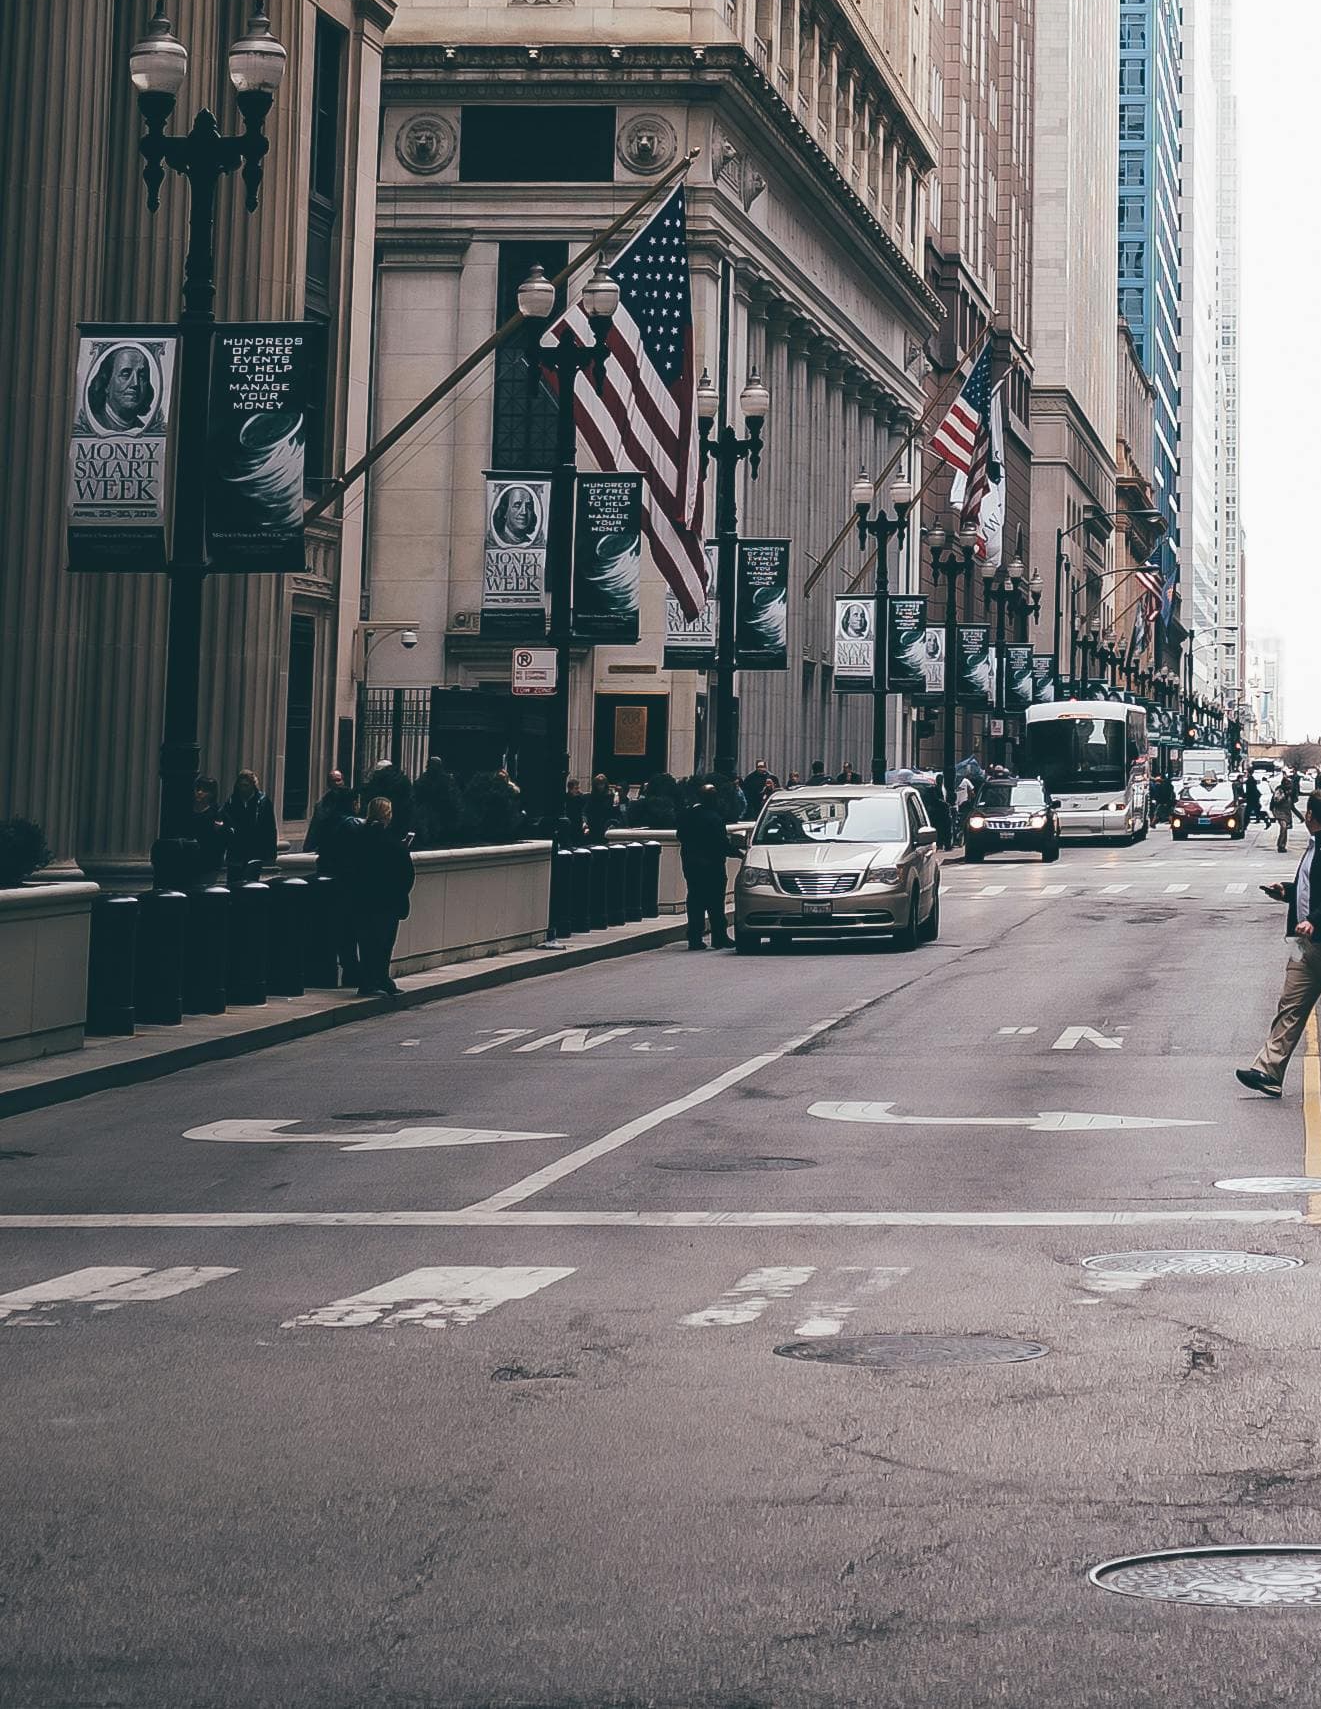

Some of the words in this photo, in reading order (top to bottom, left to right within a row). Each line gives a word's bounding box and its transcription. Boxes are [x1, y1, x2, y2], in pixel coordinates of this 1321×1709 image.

[223, 337, 303, 346] HUNDREDS
[232, 346, 251, 355] OF
[257, 346, 293, 355] FREE
[233, 355, 290, 364] EVENTS
[229, 364, 248, 373] TO
[255, 364, 293, 373] HELP
[246, 374, 275, 382] YOU
[229, 383, 290, 391] MANAGE
[239, 392, 279, 400] YOUR
[233, 401, 284, 410] MONEY
[76, 442, 160, 461] MONEY
[74, 460, 160, 480] SMART
[73, 478, 160, 501] WEEK
[487, 552, 542, 564] MONEY
[486, 562, 542, 577] SMART
[486, 576, 542, 592] WEEK
[668, 622, 712, 633] WEEK
[837, 656, 870, 666] WEEK
